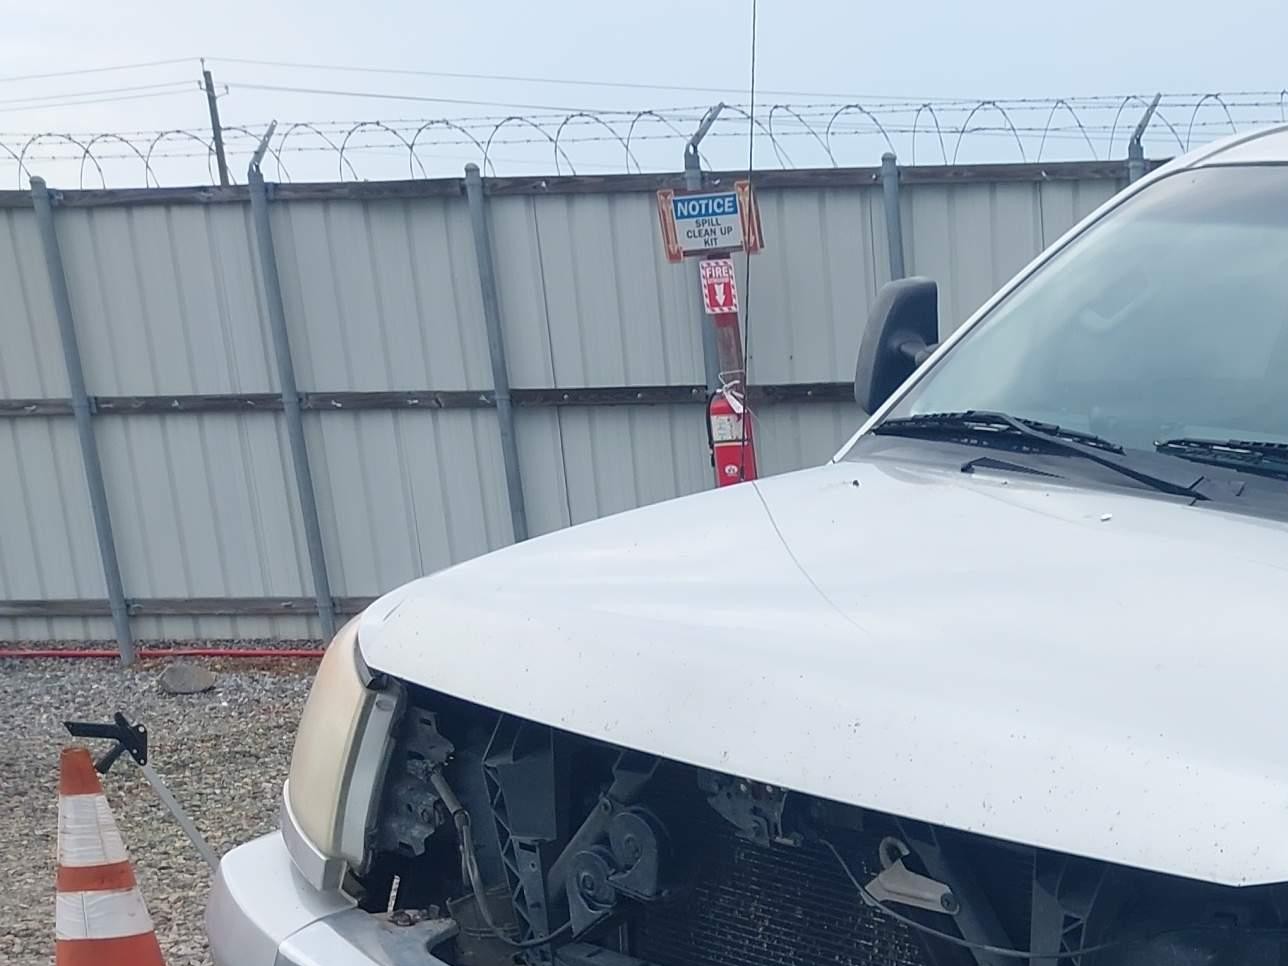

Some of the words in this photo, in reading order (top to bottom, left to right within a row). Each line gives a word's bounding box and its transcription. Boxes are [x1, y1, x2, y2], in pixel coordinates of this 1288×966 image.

[677, 196, 734, 217] NOTICE
[695, 217, 721, 228] SPILL
[686, 227, 717, 239] CLEAN
[719, 225, 733, 236] UP
[703, 237, 719, 248] KIT
[706, 266, 729, 279] FIRE
